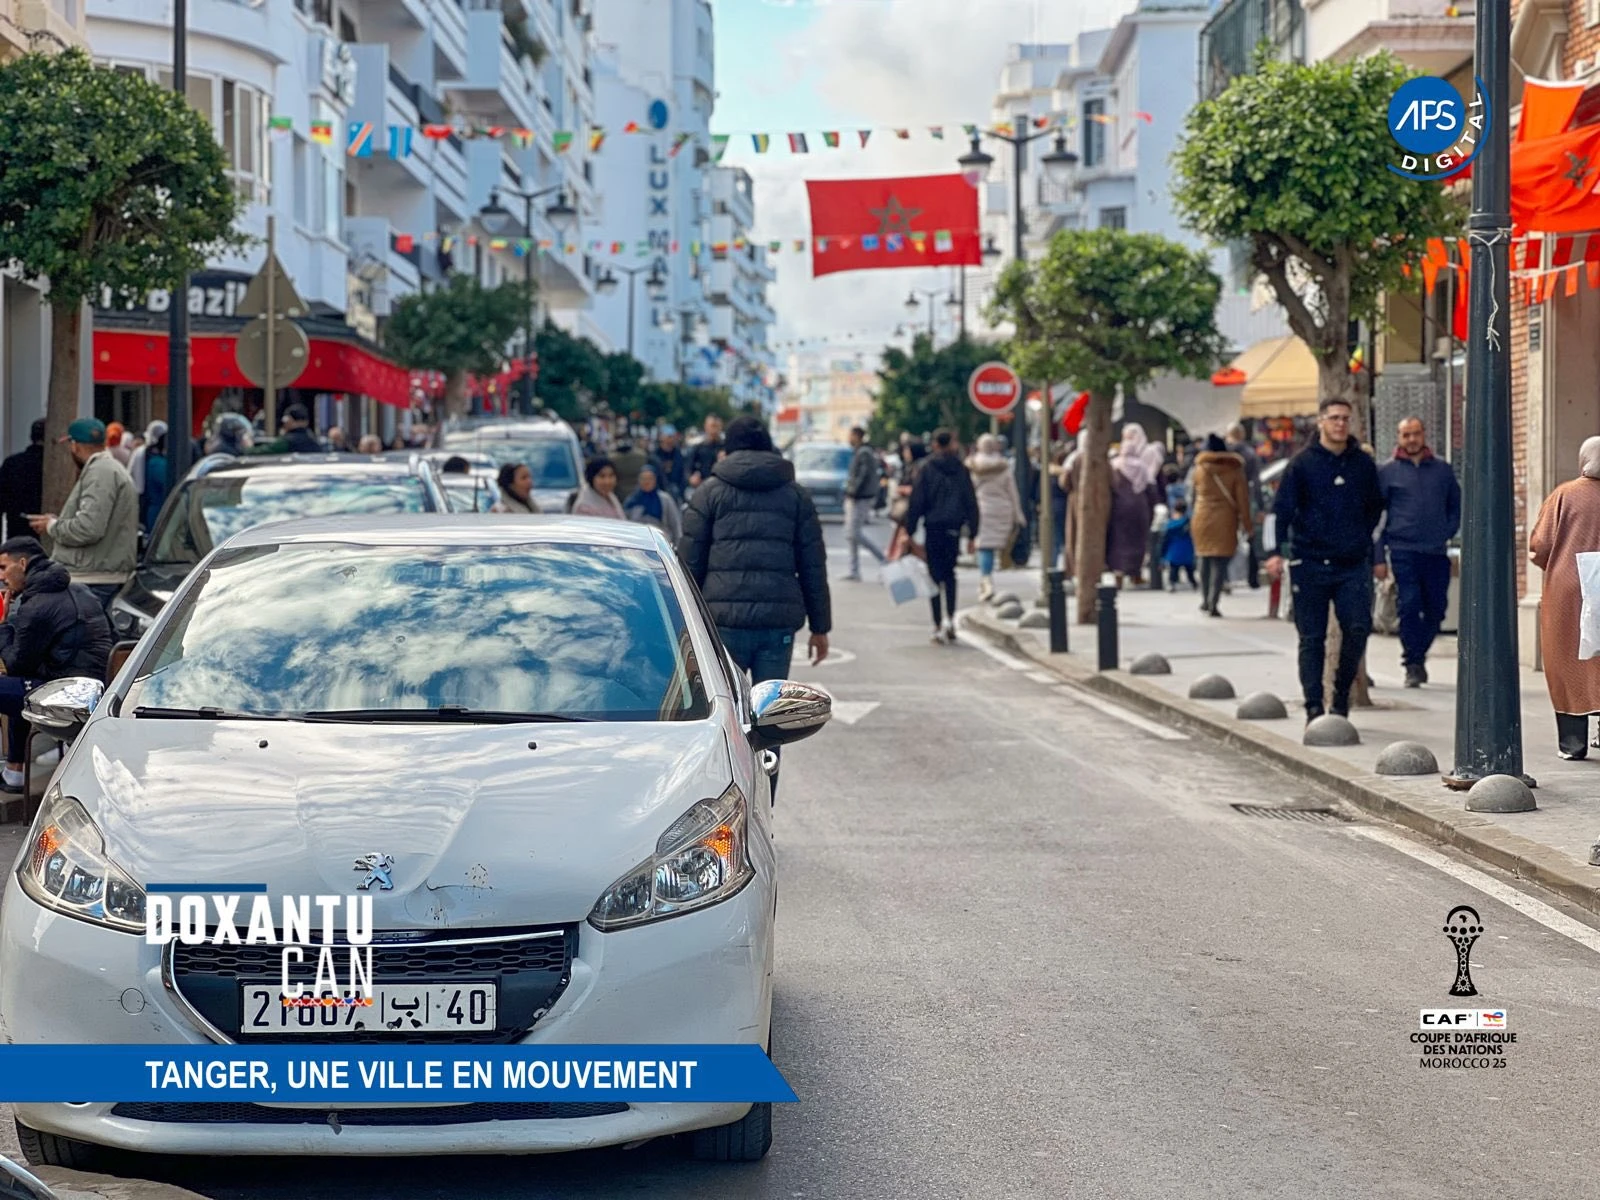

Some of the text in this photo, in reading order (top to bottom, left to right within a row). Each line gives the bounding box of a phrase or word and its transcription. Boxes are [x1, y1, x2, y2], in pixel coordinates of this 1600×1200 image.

[649, 144, 668, 216] LUX
[147, 281, 247, 316] Bazi
[447, 990, 487, 1024] 40
